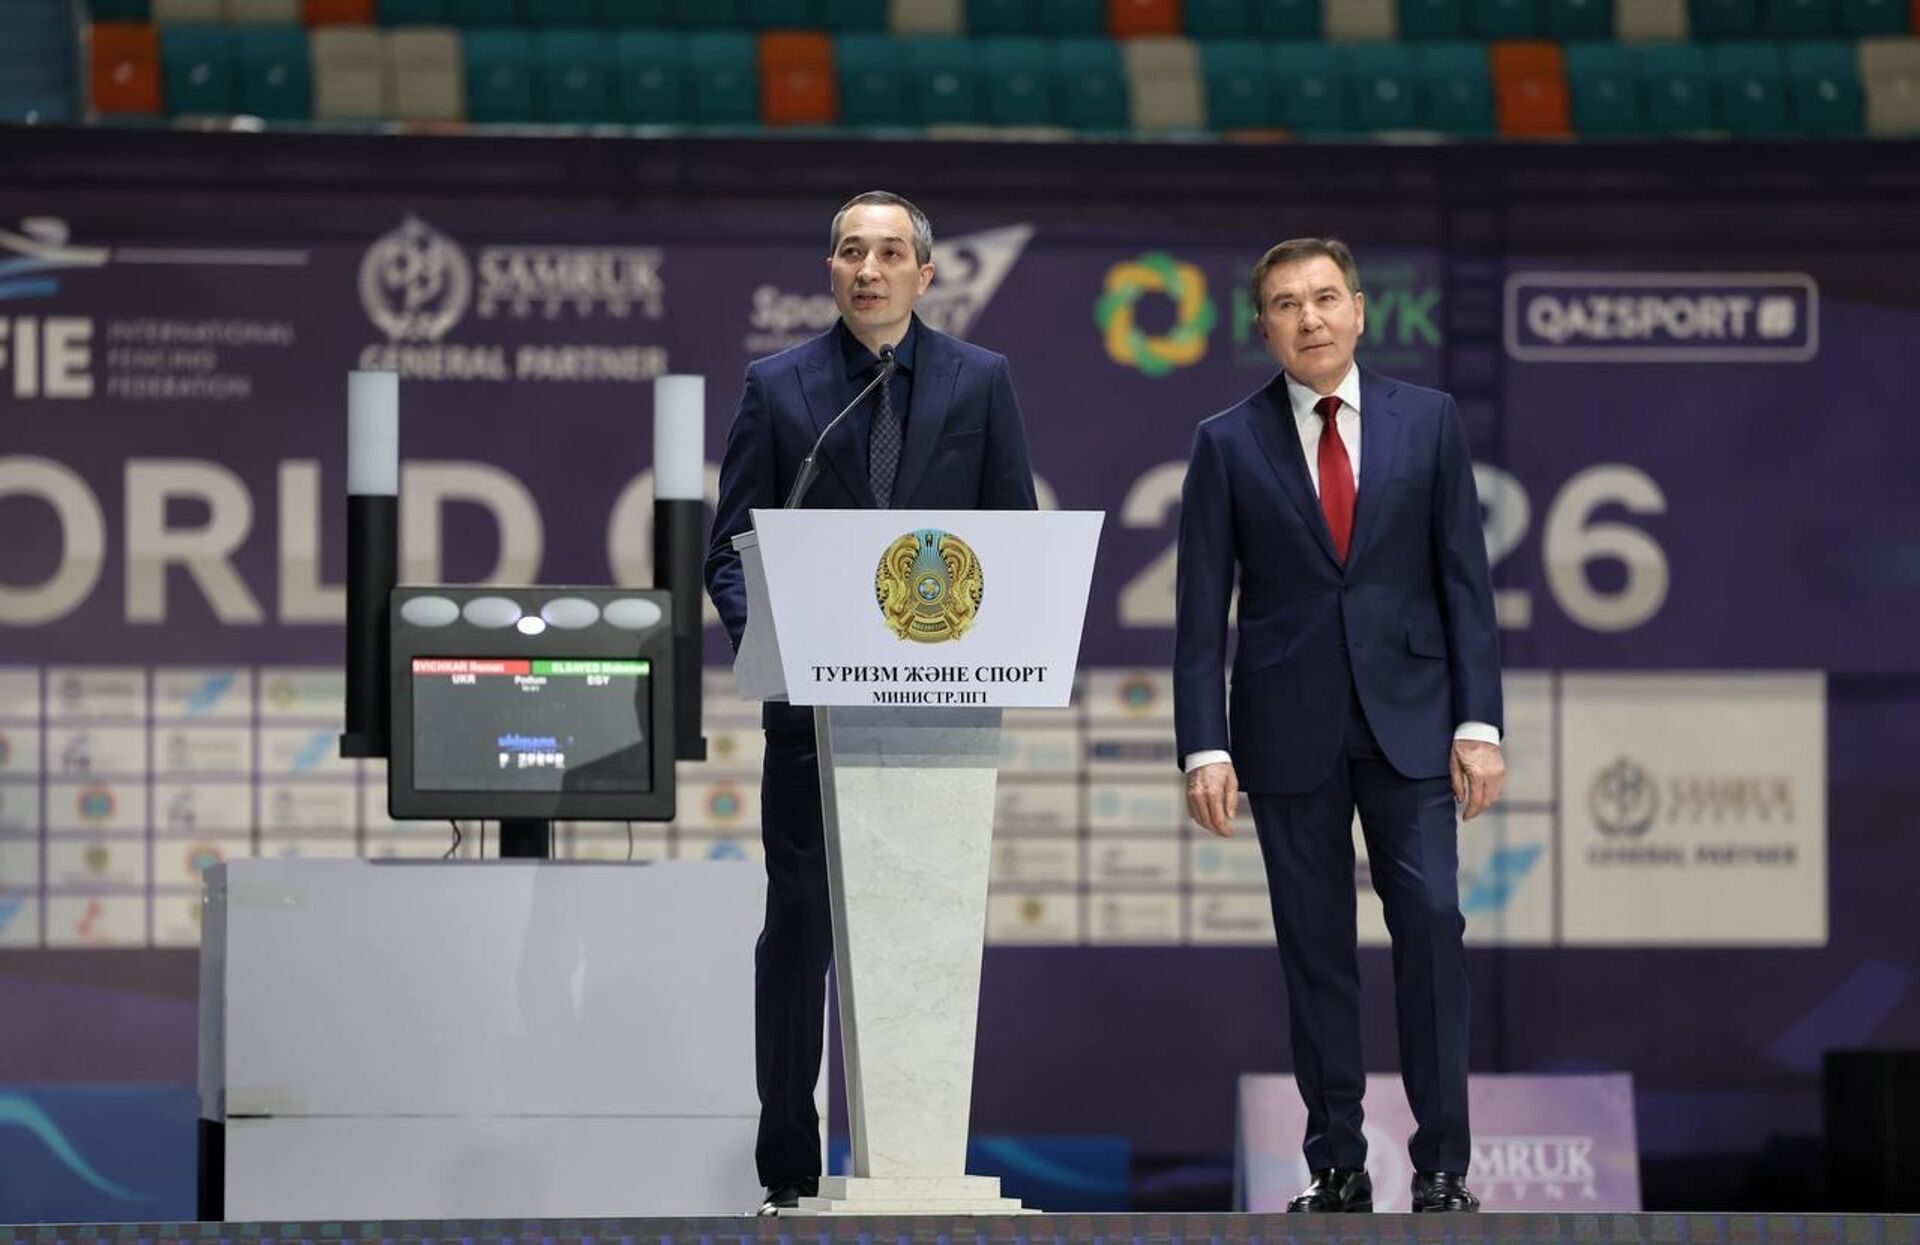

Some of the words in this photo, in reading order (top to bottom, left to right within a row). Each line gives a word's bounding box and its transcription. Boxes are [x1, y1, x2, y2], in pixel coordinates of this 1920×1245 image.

[478, 248, 664, 293] SAMRUK
[1526, 295, 1753, 342] QAZSPORT
[0, 315, 94, 398] IE
[359, 344, 506, 380] GENERAL
[515, 345, 668, 381] PARTNER
[811, 666, 898, 683] ТУРИЗМ
[904, 666, 969, 683] ЖӘНЕ
[975, 666, 1048, 683] СПОРТ
[872, 691, 987, 704] МИНИСТРЛІГІ
[1469, 1137, 1597, 1181] MRUK
